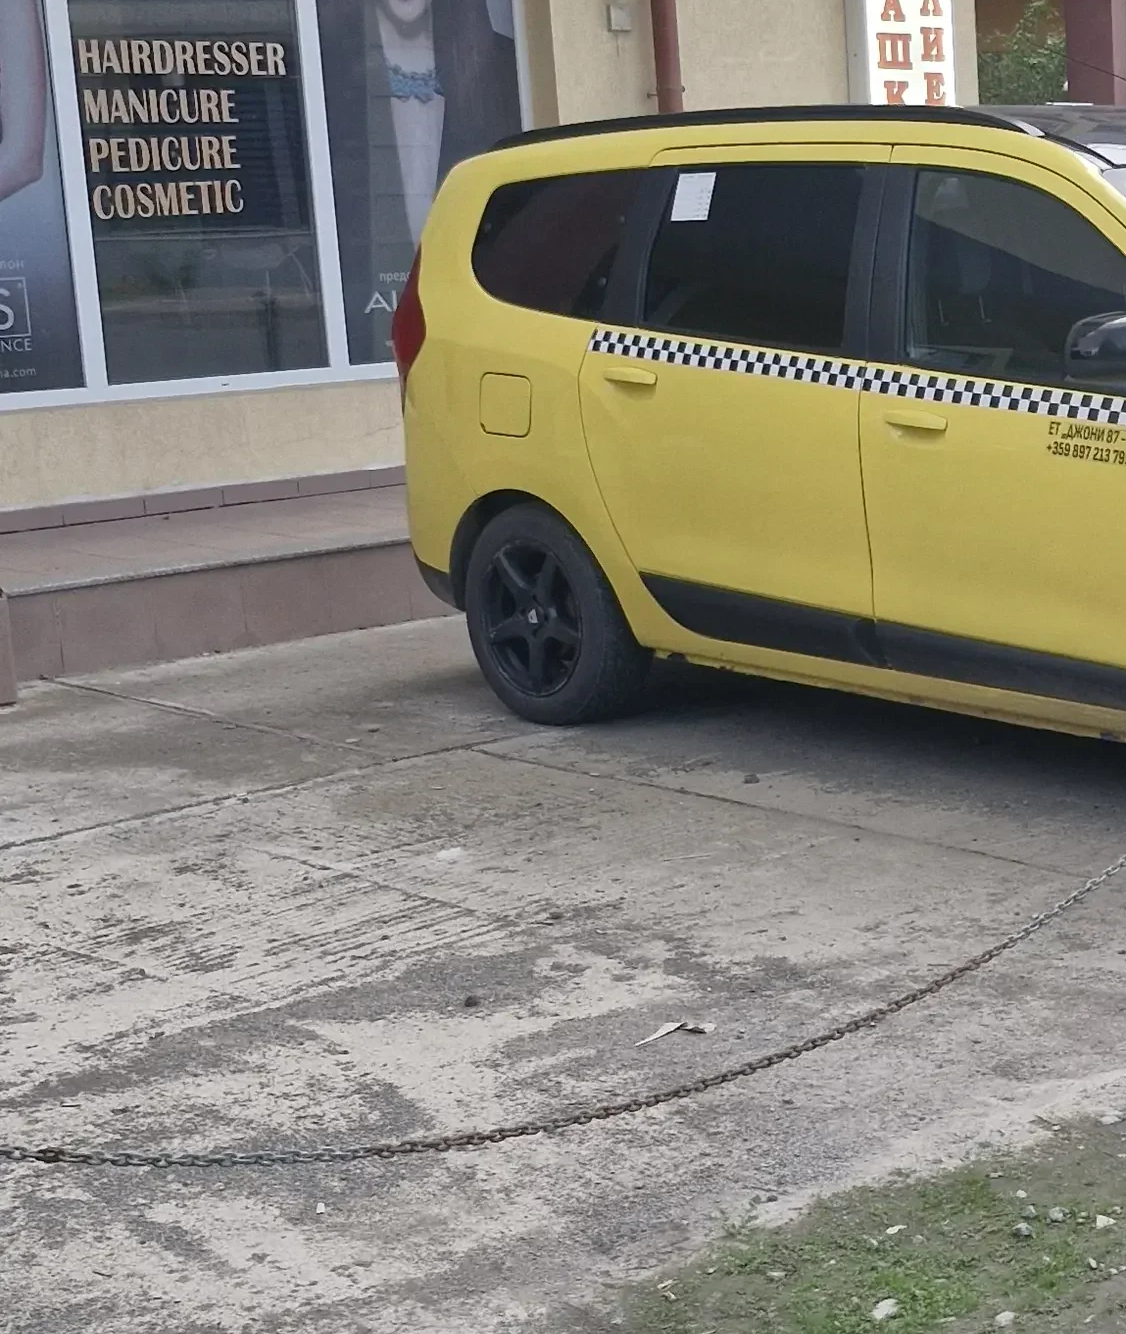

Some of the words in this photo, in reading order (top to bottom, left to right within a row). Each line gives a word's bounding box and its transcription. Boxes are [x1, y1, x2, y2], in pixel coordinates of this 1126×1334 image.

[77, 39, 287, 76] HAIRDRESSER
[83, 88, 240, 124] MANICURE
[88, 135, 242, 173] PEDICURE
[93, 179, 245, 220] COSMETIC
[1046, 441, 1070, 457] +359
[1072, 444, 1092, 460] 897
[1093, 447, 1110, 463] 213
[1106, 429, 1120, 444] 87
